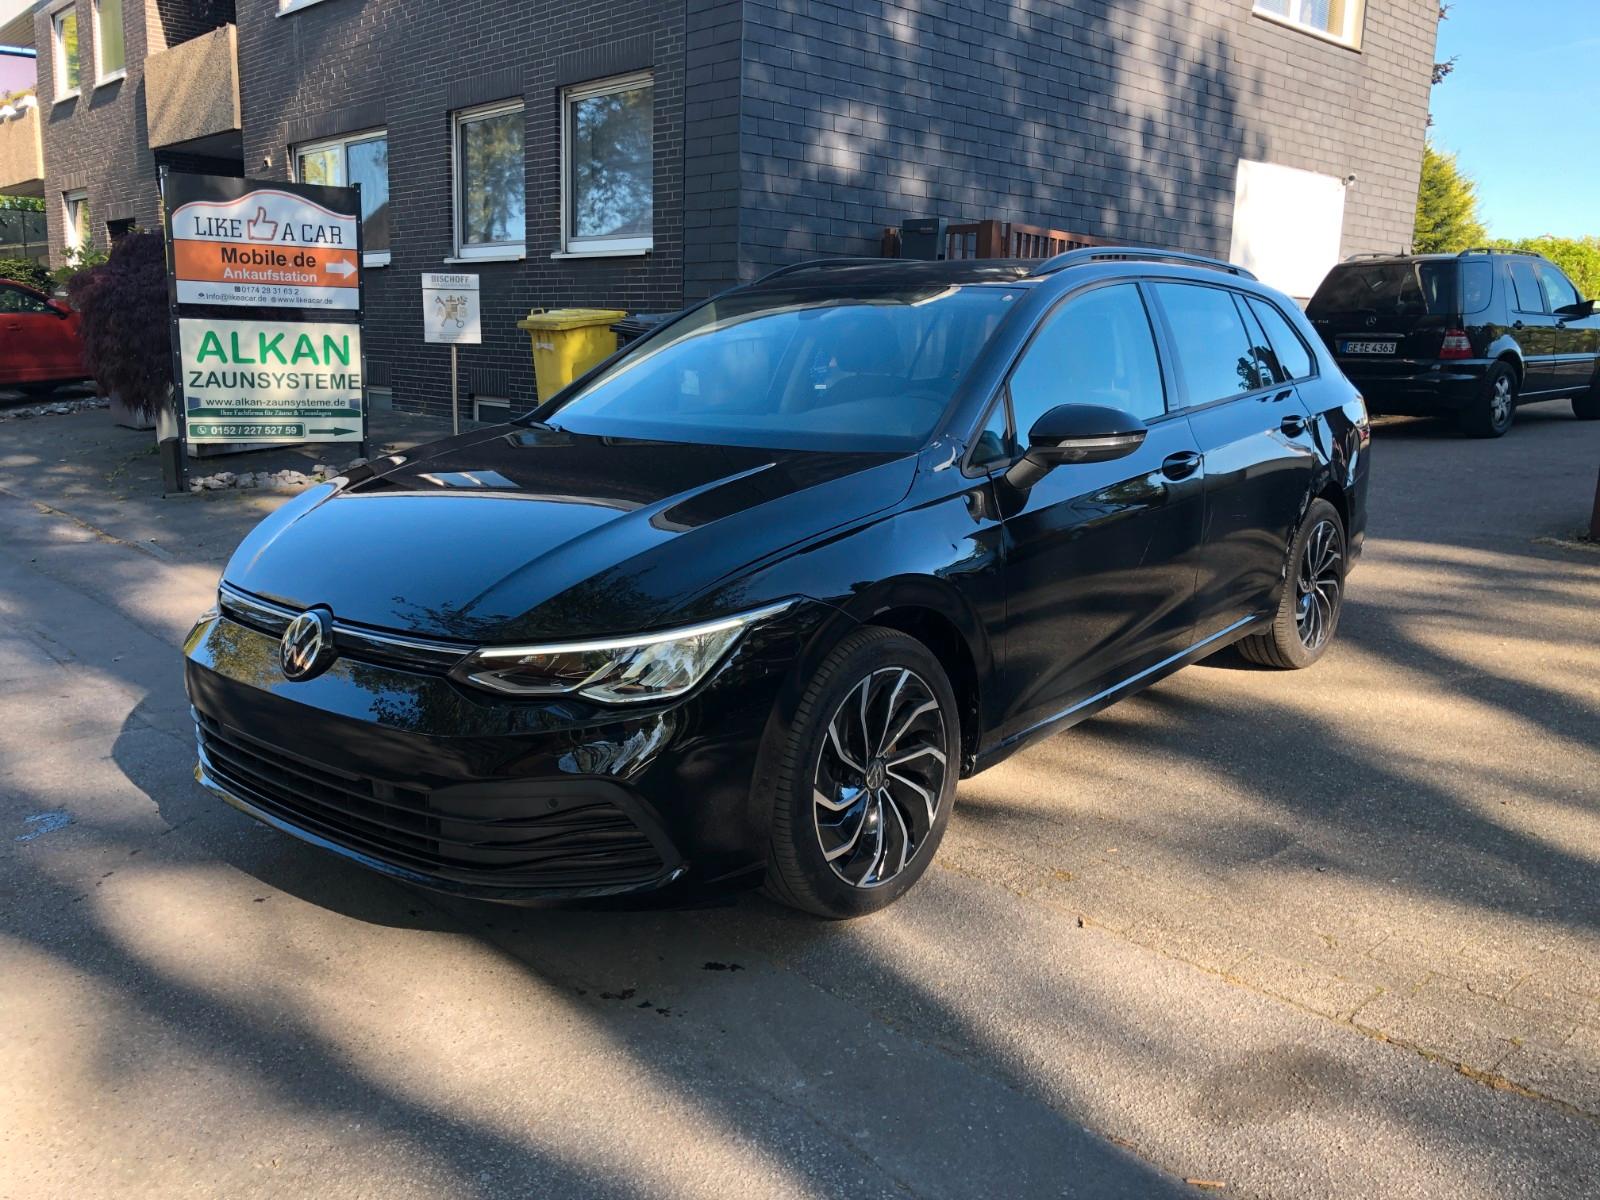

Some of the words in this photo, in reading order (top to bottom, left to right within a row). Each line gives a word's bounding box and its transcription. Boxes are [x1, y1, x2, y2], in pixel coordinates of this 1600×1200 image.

[194, 216, 242, 238] LIKE
[281, 222, 297, 241] A
[301, 224, 343, 244] CAR
[221, 247, 316, 267] Mobile.de
[223, 267, 318, 283] Ankaufstation
[431, 275, 469, 283] BISCHOFF
[196, 331, 350, 366] ALKAN
[1347, 343, 1358, 352] GE
[1364, 343, 1370, 352] E
[1372, 343, 1395, 353] 4363
[189, 370, 361, 390] ZAUNSYSTEME
[205, 397, 346, 408] www.alkan-zaunsysteme.de
[211, 426, 236, 435] 0152
[243, 426, 262, 435] 227
[264, 426, 283, 435] 527
[285, 426, 297, 434] 59
